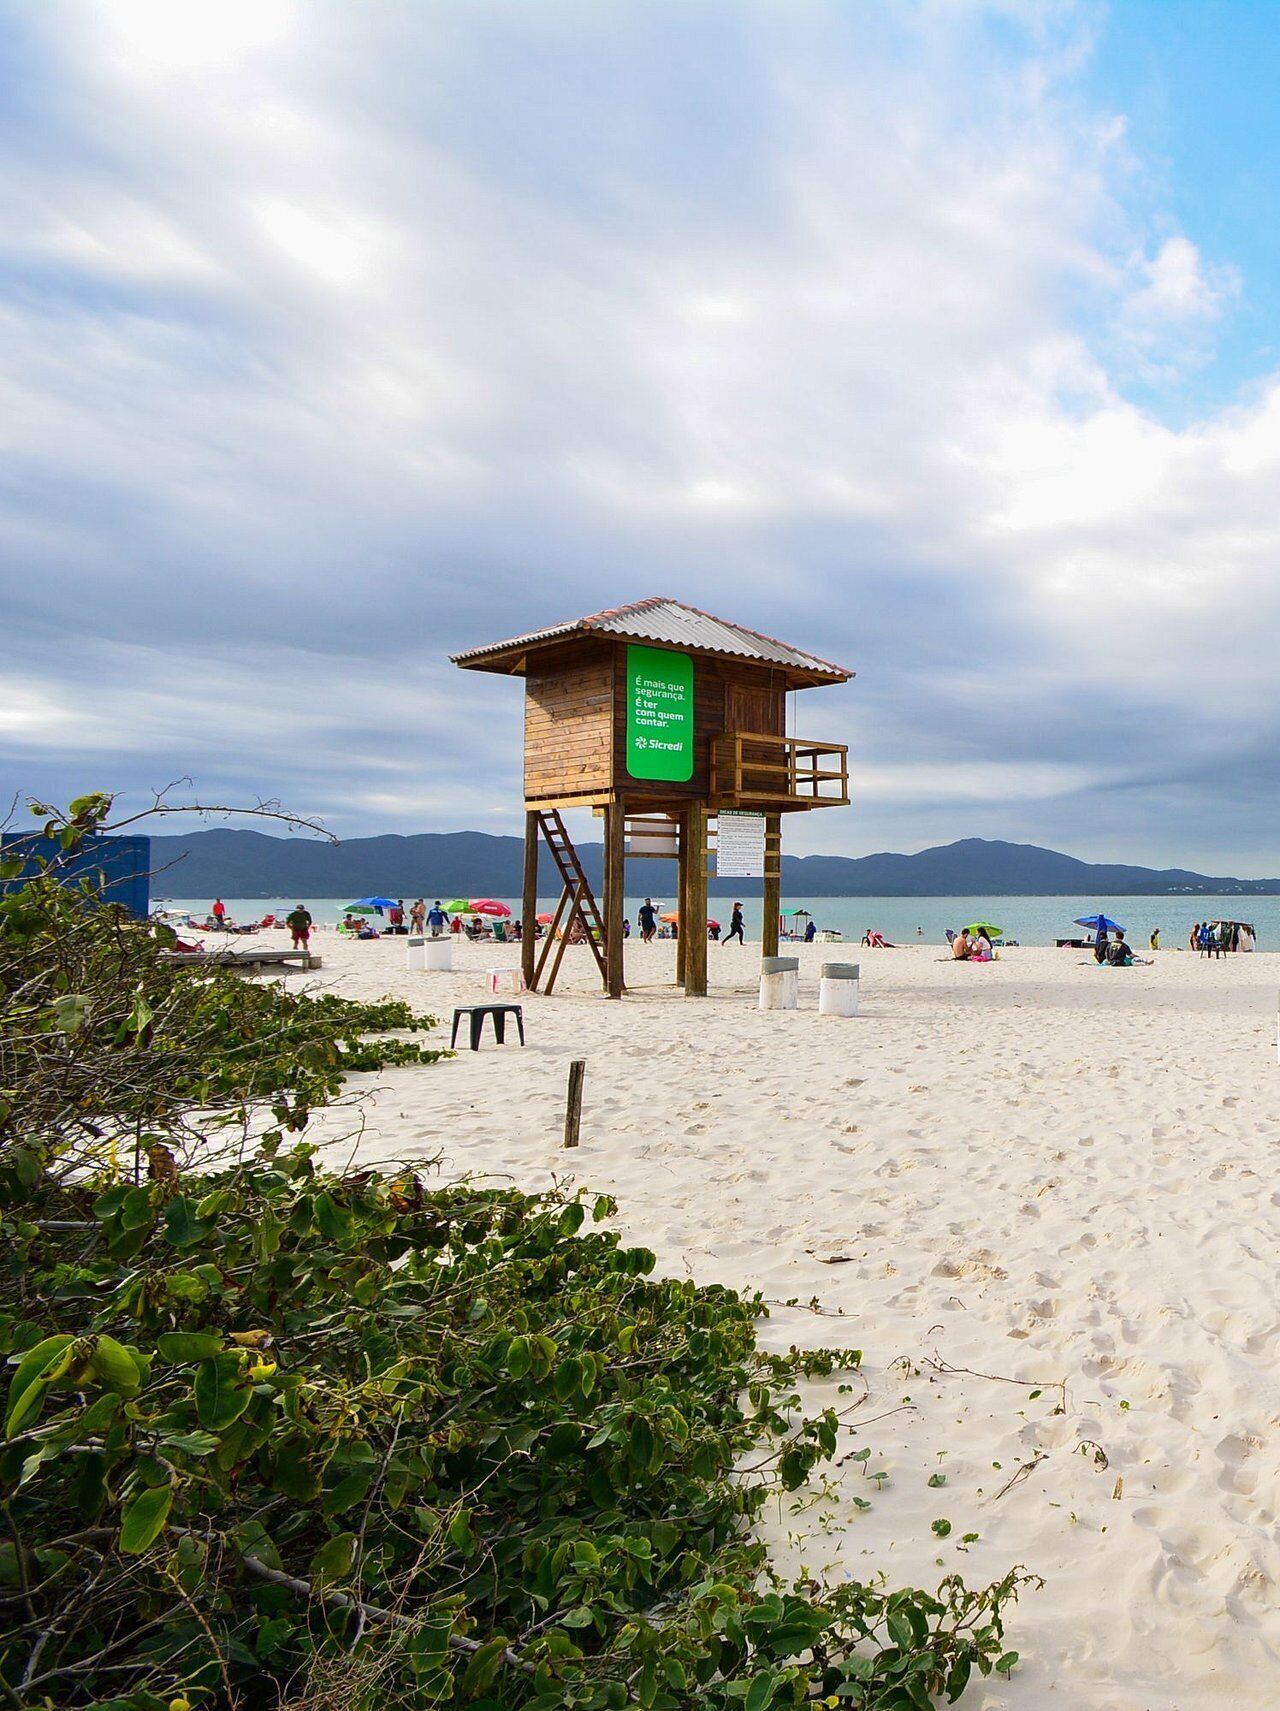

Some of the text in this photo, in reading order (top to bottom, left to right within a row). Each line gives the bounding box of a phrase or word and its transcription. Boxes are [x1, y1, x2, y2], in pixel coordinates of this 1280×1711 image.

[635, 675, 685, 692] É mais que
[635, 687, 685, 701] segurança.
[635, 696, 658, 709] É ter
[635, 709, 684, 721] com quem
[635, 717, 669, 728] contar.
[649, 740, 683, 751] Sicredi
